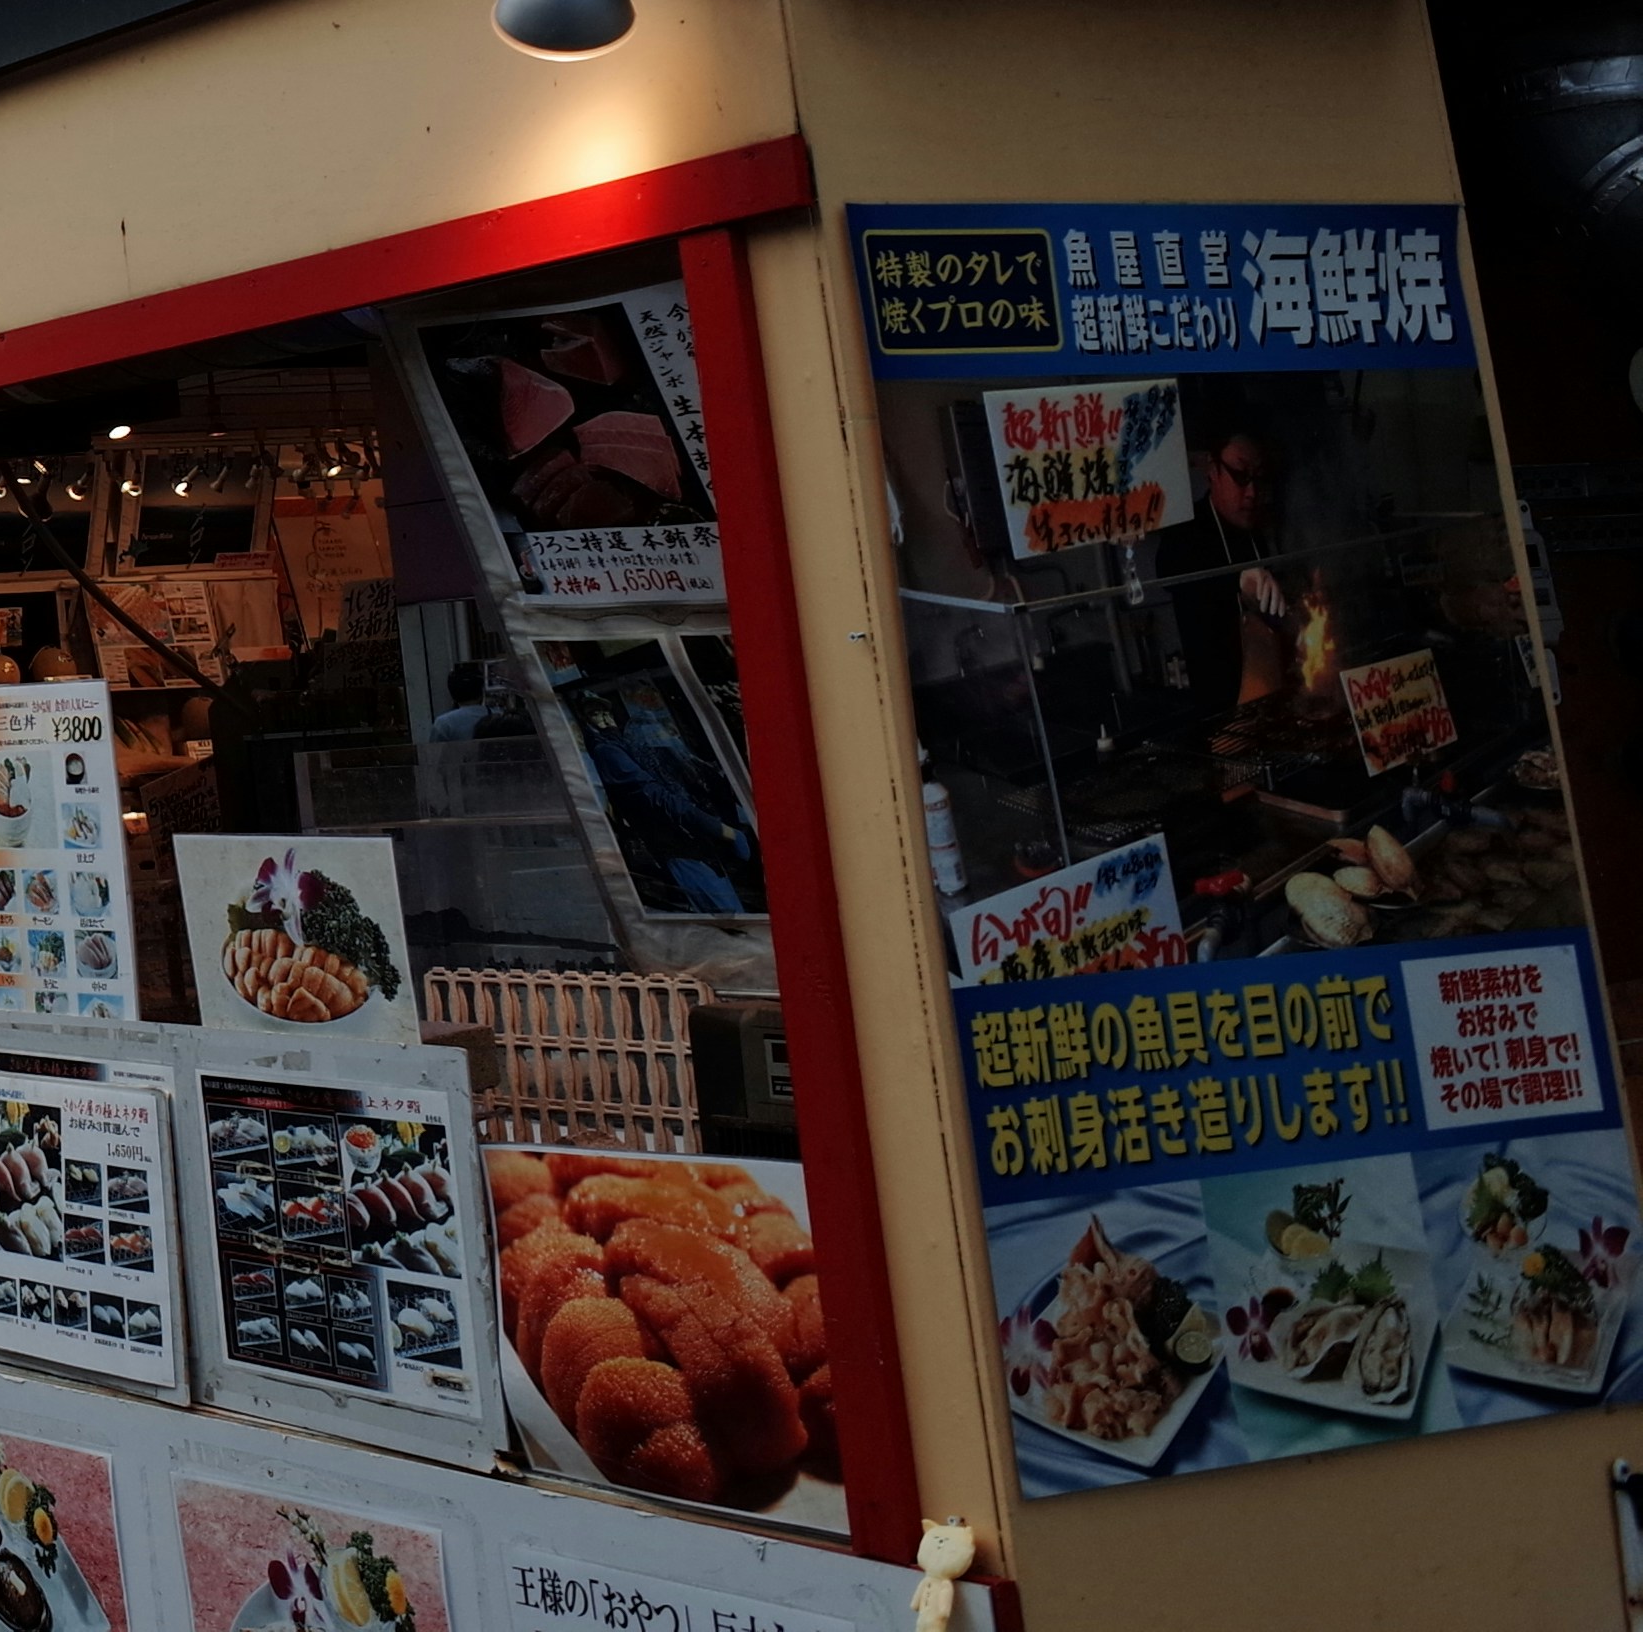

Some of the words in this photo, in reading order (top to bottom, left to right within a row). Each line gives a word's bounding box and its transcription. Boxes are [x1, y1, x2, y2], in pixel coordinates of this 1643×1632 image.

[874, 249, 1045, 289] 特製のタレで
[1062, 228, 1232, 289] 魚屋直営
[1240, 227, 1456, 348] 海鮮焼
[880, 295, 1052, 336] 焼くプロの味
[1071, 294, 1241, 355] 超新鮮こだわり
[532, 530, 634, 556] うろこ特選
[553, 575, 601, 596] 大特価
[52, 716, 103, 743] ¥3800
[1438, 962, 1545, 1004] 新鮮素材を
[970, 974, 1394, 1089] 超新鮮の魚貝を目の前で
[1456, 1001, 1540, 1038] お好みで
[1431, 1042, 1500, 1078] 焼いて!
[1507, 1032, 1581, 1072] 刺身で!
[1439, 1072, 1585, 1113] その場で調理!!
[986, 1058, 1412, 1177] お刺身活き造りします!!
[107, 1142, 144, 1161] 1,650円
